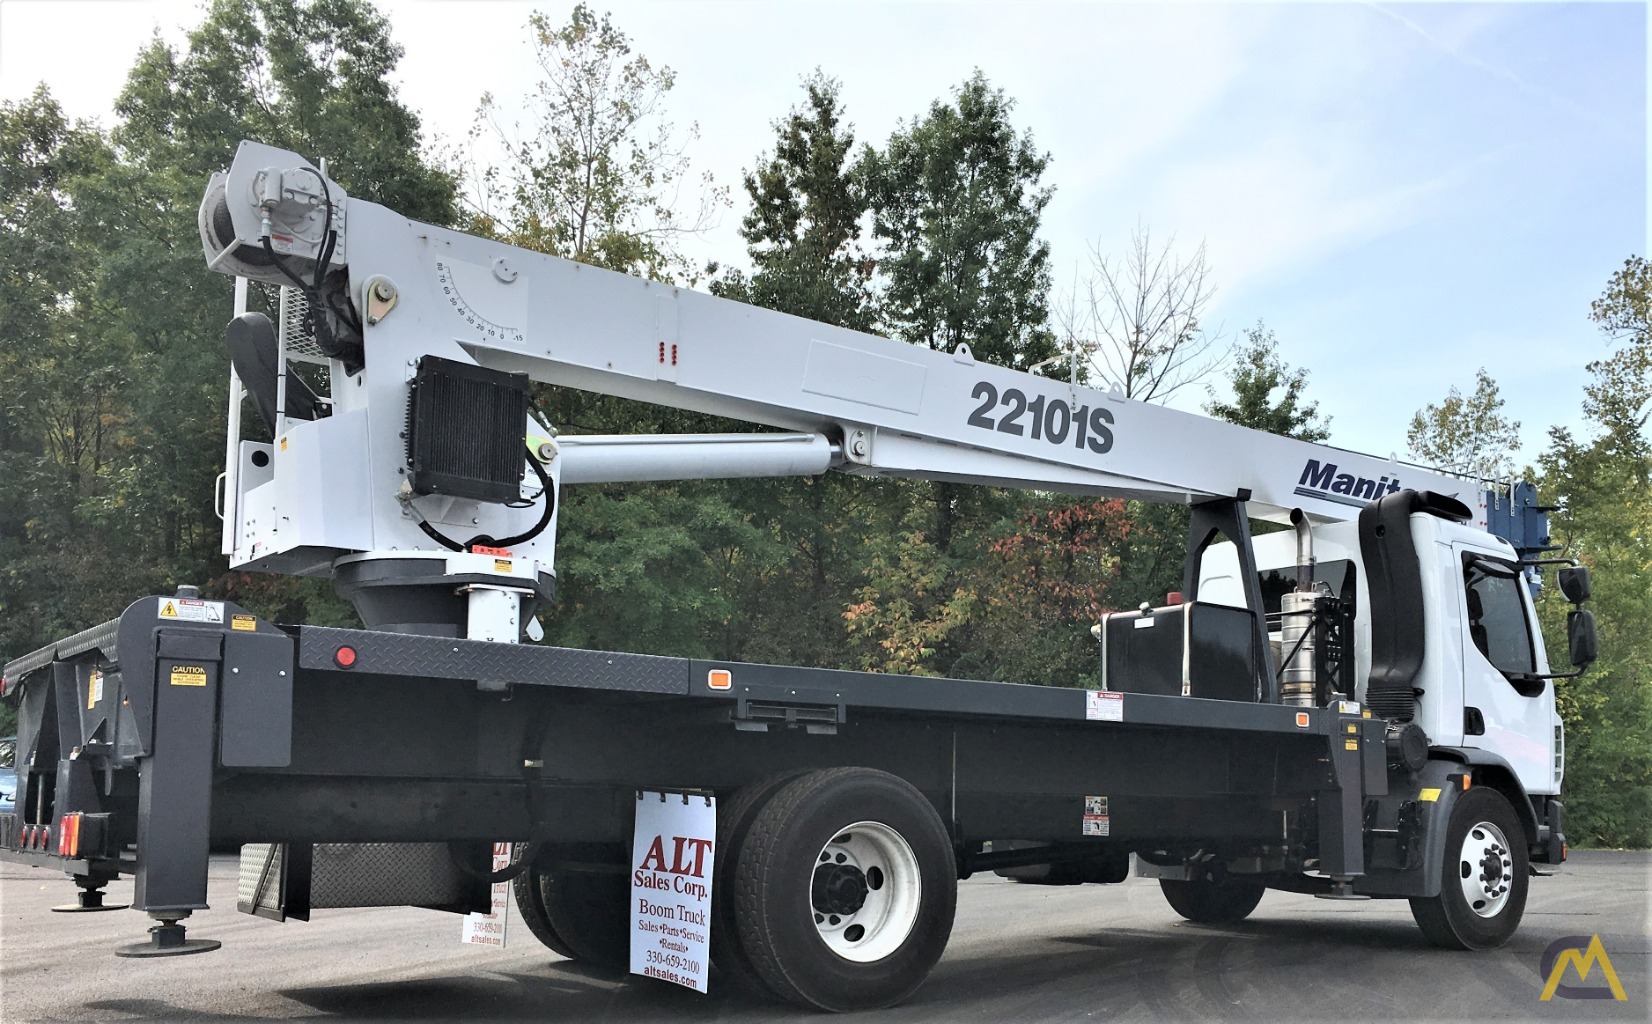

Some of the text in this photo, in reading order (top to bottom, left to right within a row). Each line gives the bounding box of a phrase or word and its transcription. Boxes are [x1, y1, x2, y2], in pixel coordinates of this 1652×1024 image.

[437, 262, 443, 271] 80
[439, 274, 446, 283] 70
[457, 308, 465, 316] 40
[466, 316, 475, 324] 30
[476, 323, 485, 331] 20
[967, 381, 1115, 454] 22101S
[172, 666, 205, 674] CAUTION
[639, 834, 712, 878] ALT
[634, 869, 708, 901] Sales Corp.
[639, 899, 706, 926] Boom Truck
[638, 919, 659, 932] Sales
[646, 950, 700, 974] 330-659-2100
[644, 965, 697, 989] altsales.com
